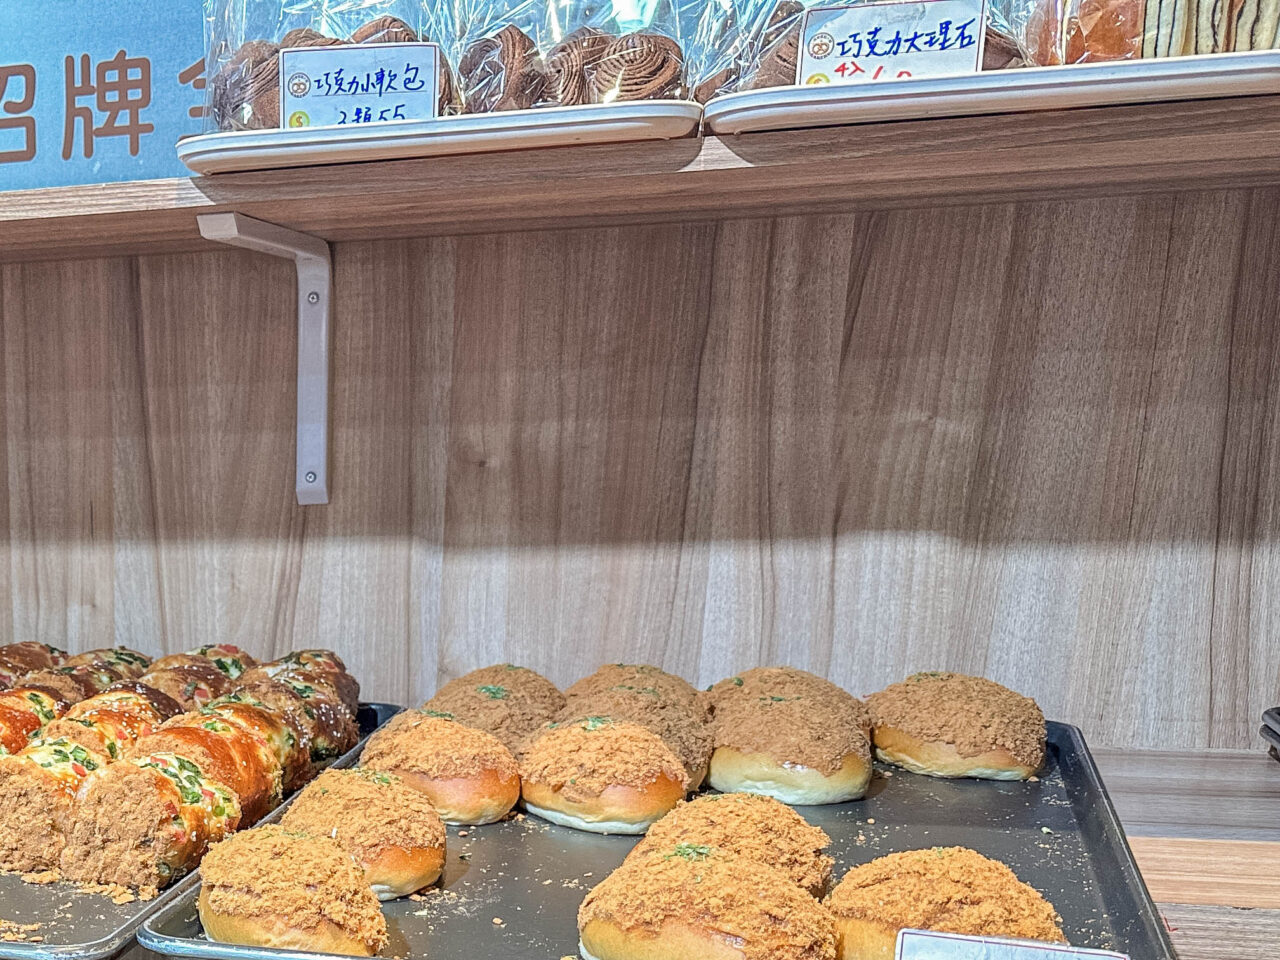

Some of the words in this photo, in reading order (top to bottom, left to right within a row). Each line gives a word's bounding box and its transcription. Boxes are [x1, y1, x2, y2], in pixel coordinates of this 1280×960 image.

[836, 17, 976, 58] 巧克力大理石
[313, 63, 425, 97] 巧克力小軟包
